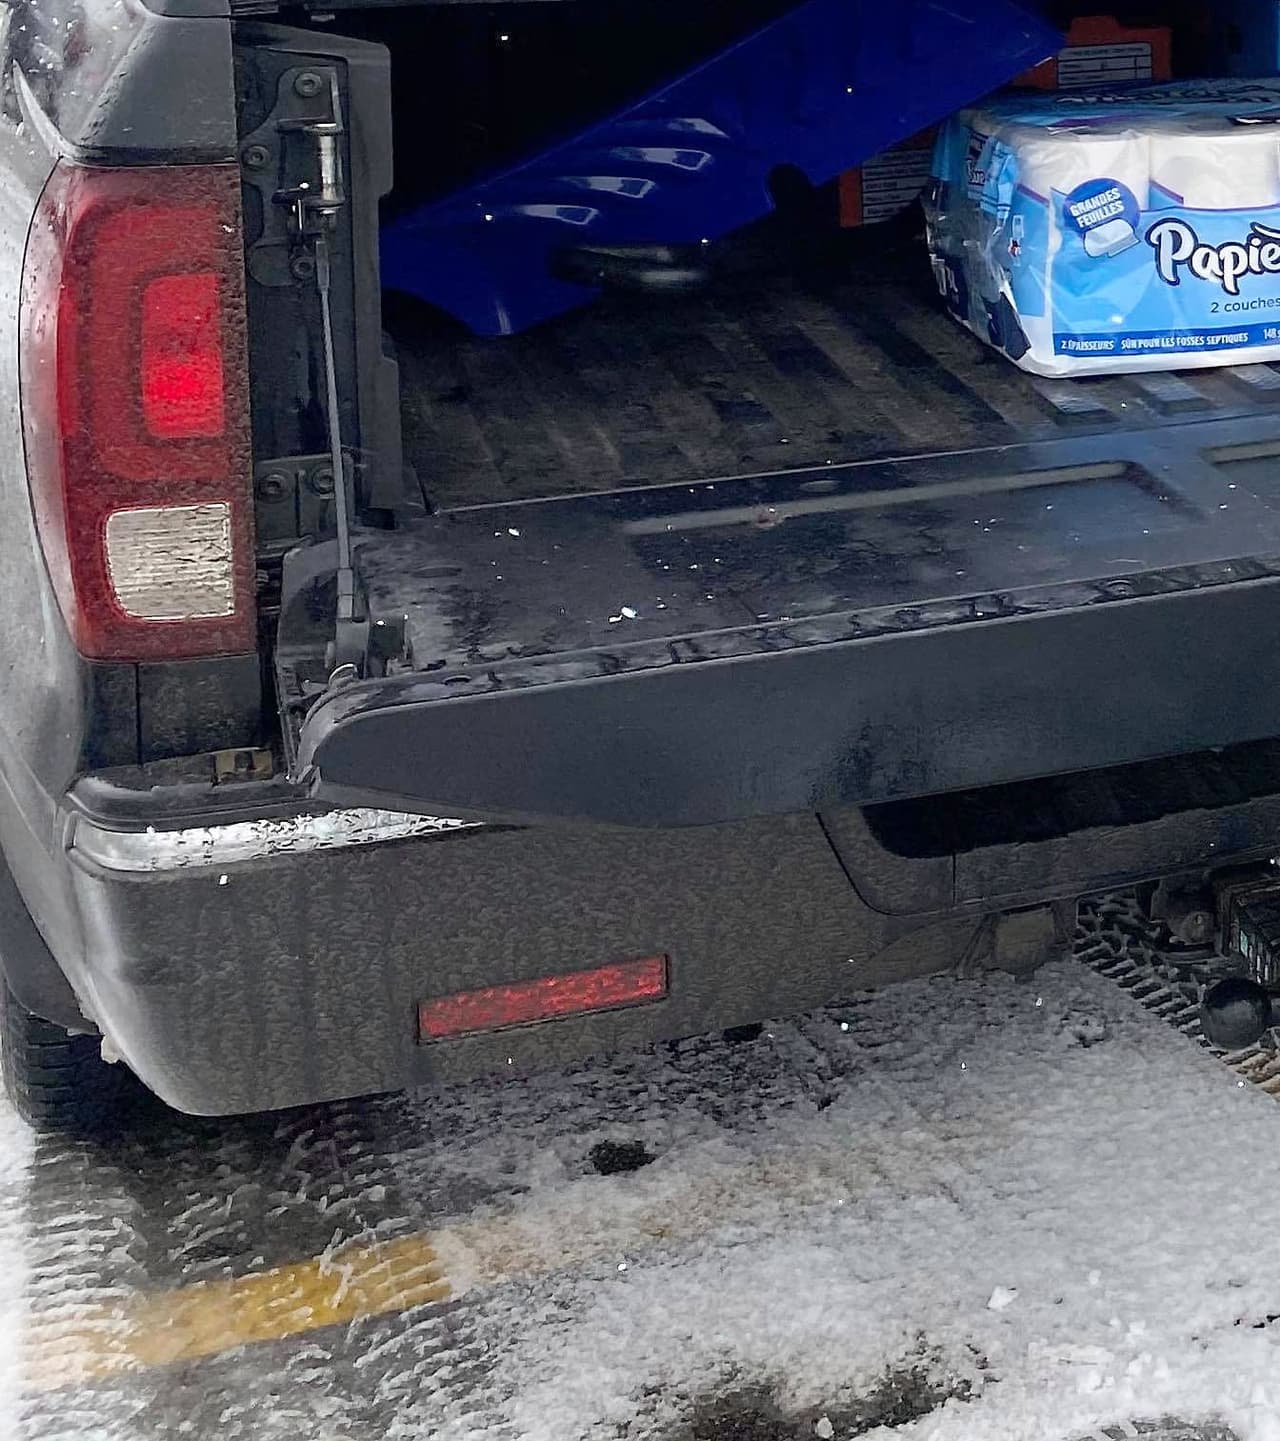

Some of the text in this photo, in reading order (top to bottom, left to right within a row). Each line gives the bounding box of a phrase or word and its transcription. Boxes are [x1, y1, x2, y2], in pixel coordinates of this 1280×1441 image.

[1070, 187, 1121, 217] GRANDES
[1077, 200, 1125, 228] FEUILLES
[1211, 302, 1219, 313] 2
